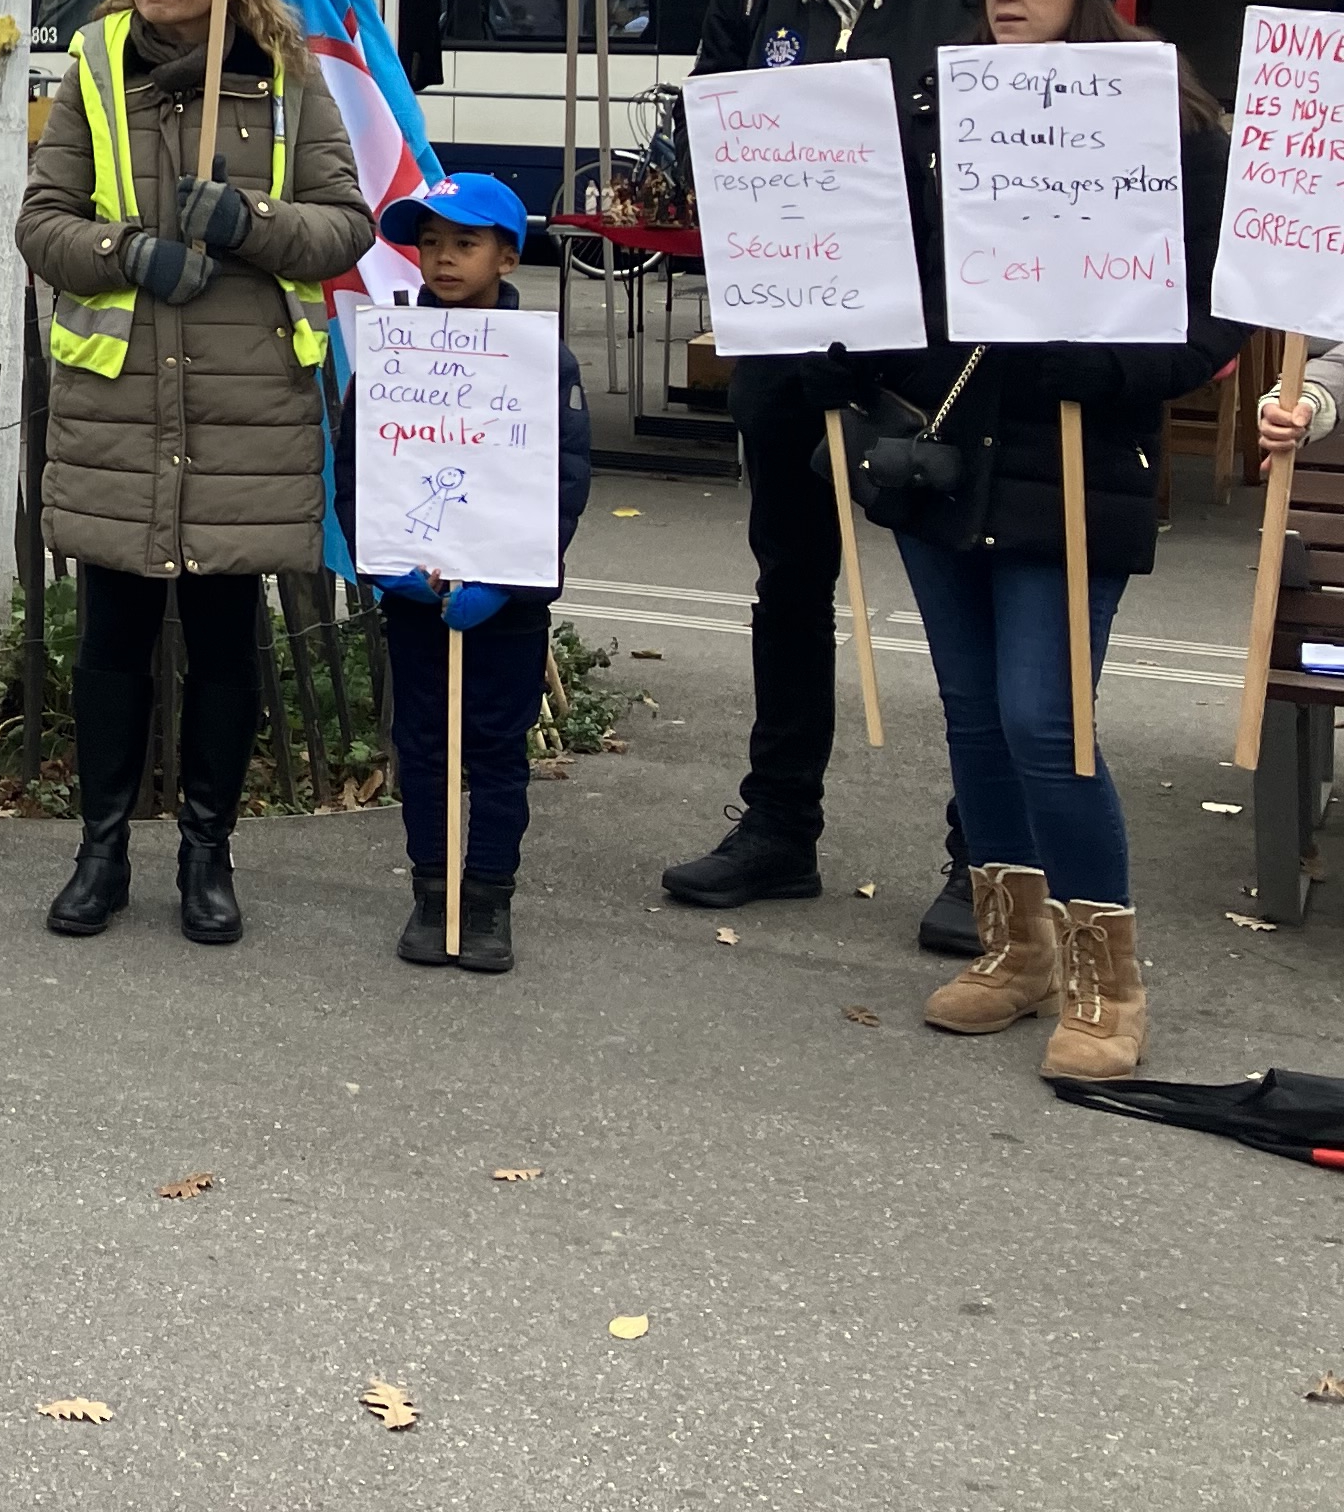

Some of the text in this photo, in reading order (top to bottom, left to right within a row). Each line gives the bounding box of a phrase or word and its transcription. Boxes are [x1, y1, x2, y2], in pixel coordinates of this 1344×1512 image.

[949, 59, 1124, 109] 56 enfants
[1254, 61, 1320, 94] NOUS
[699, 90, 781, 131] Taux
[1245, 93, 1282, 118] LES
[958, 117, 1107, 150] 2 adultes
[1241, 125, 1280, 151] DE
[714, 136, 876, 165] d'encadrement
[712, 169, 841, 202] respecté
[957, 161, 1179, 206] 3 passages piétons
[1242, 161, 1323, 194] NOTRE
[1234, 208, 1344, 255] CORRECTE
[959, 247, 1047, 286] C'est
[723, 275, 866, 310] assurée
[367, 311, 498, 353] J'ai droit
[384, 350, 476, 378] à un
[369, 382, 522, 412] accueil de
[378, 415, 501, 457] qualité
